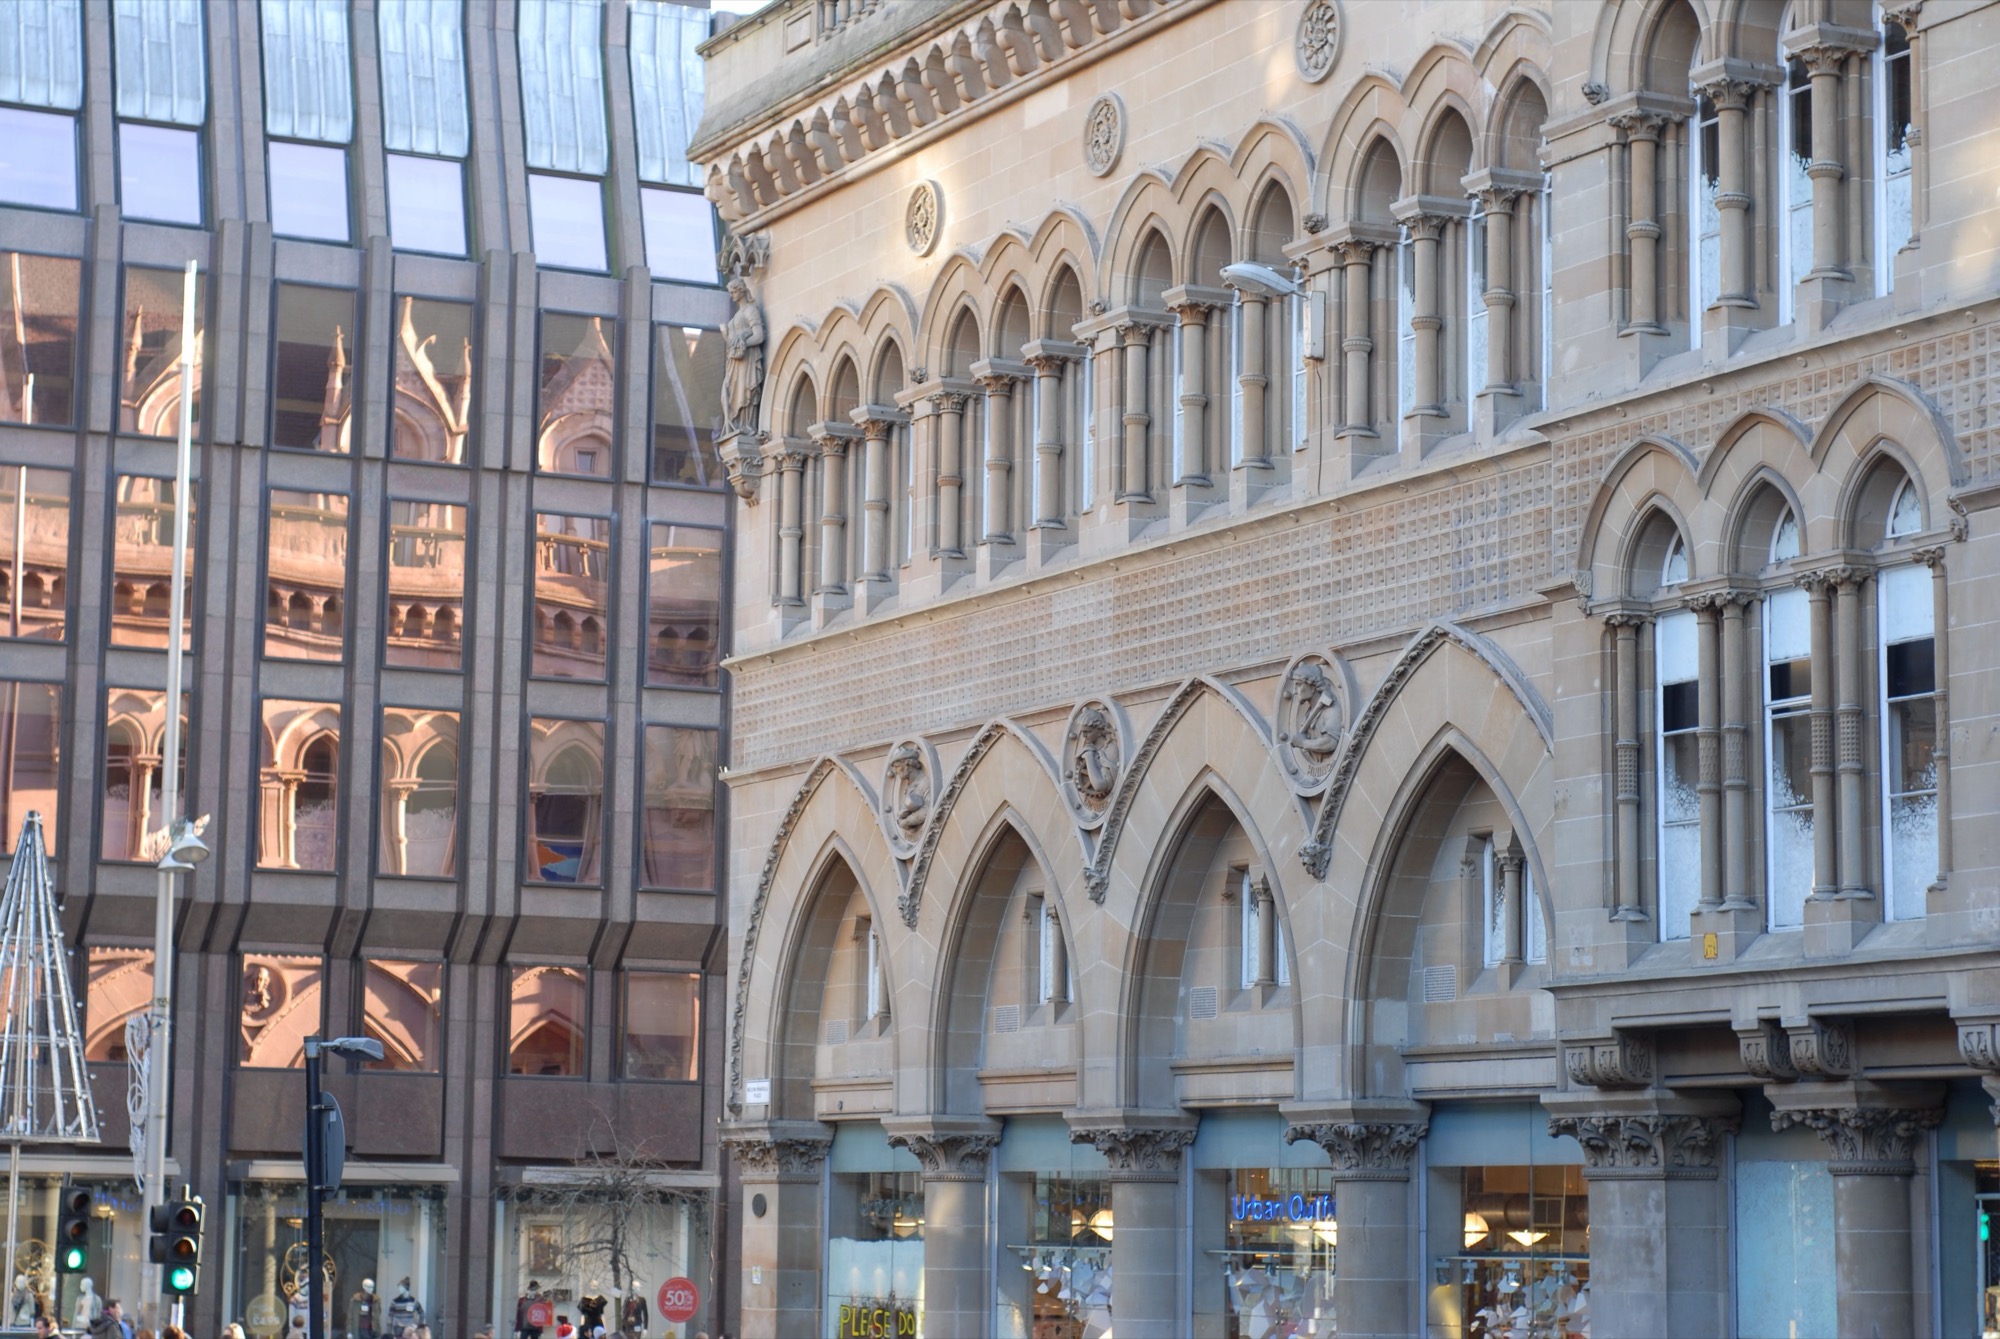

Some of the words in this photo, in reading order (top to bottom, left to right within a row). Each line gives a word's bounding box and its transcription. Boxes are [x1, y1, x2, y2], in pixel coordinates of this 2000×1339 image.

[1233, 1194, 1284, 1221] Urban
[840, 1305, 891, 1339] PLEASE
[899, 1311, 915, 1336] DO
